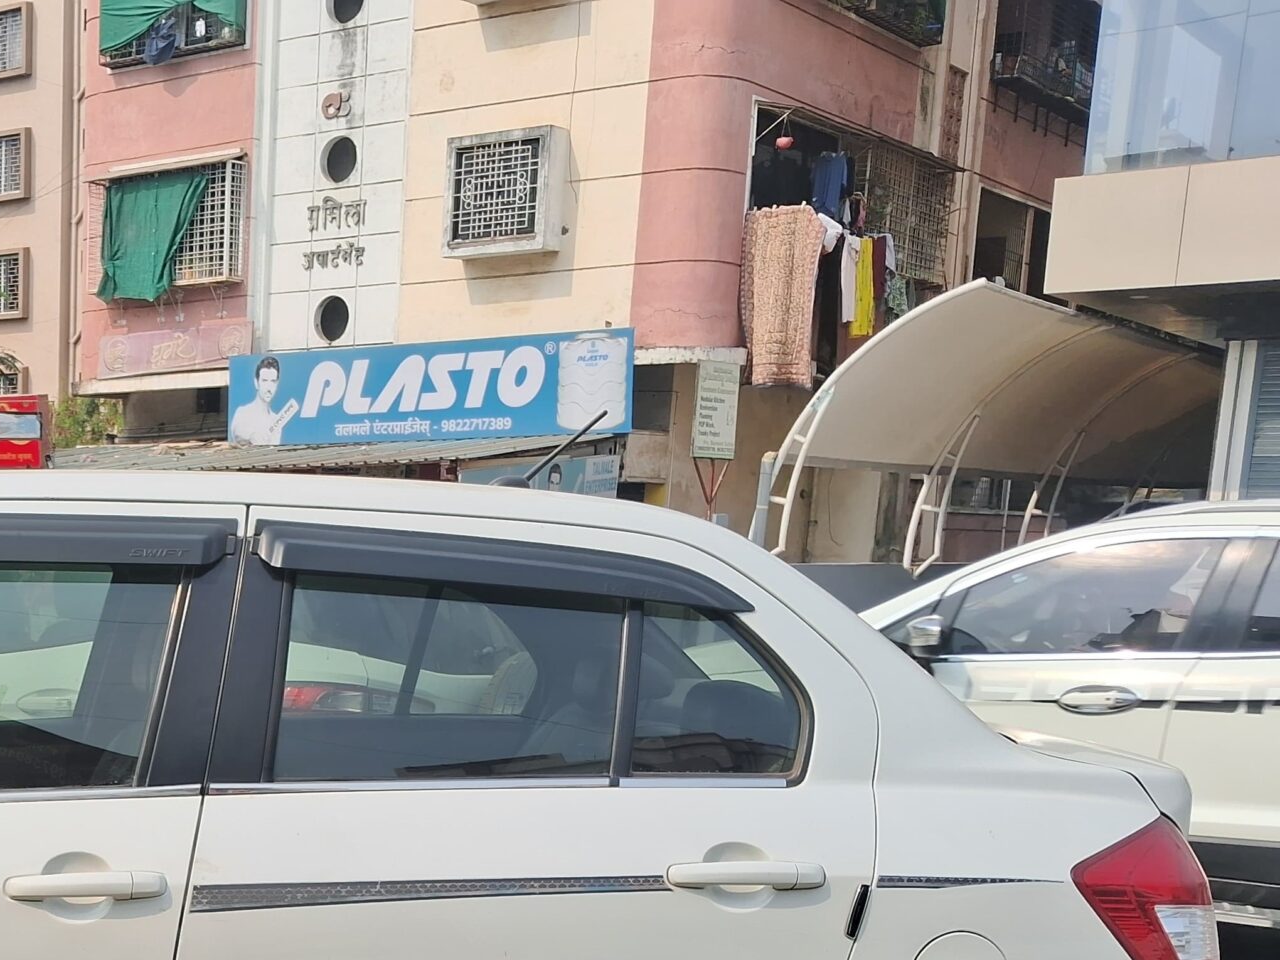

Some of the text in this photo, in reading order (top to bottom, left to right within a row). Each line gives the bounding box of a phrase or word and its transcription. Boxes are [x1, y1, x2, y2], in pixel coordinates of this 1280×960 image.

[300, 345, 546, 419] PLASTO
[335, 419, 370, 436] तलमले
[440, 417, 513, 433] 9822717389
[129, 547, 192, 558] SWIFT
